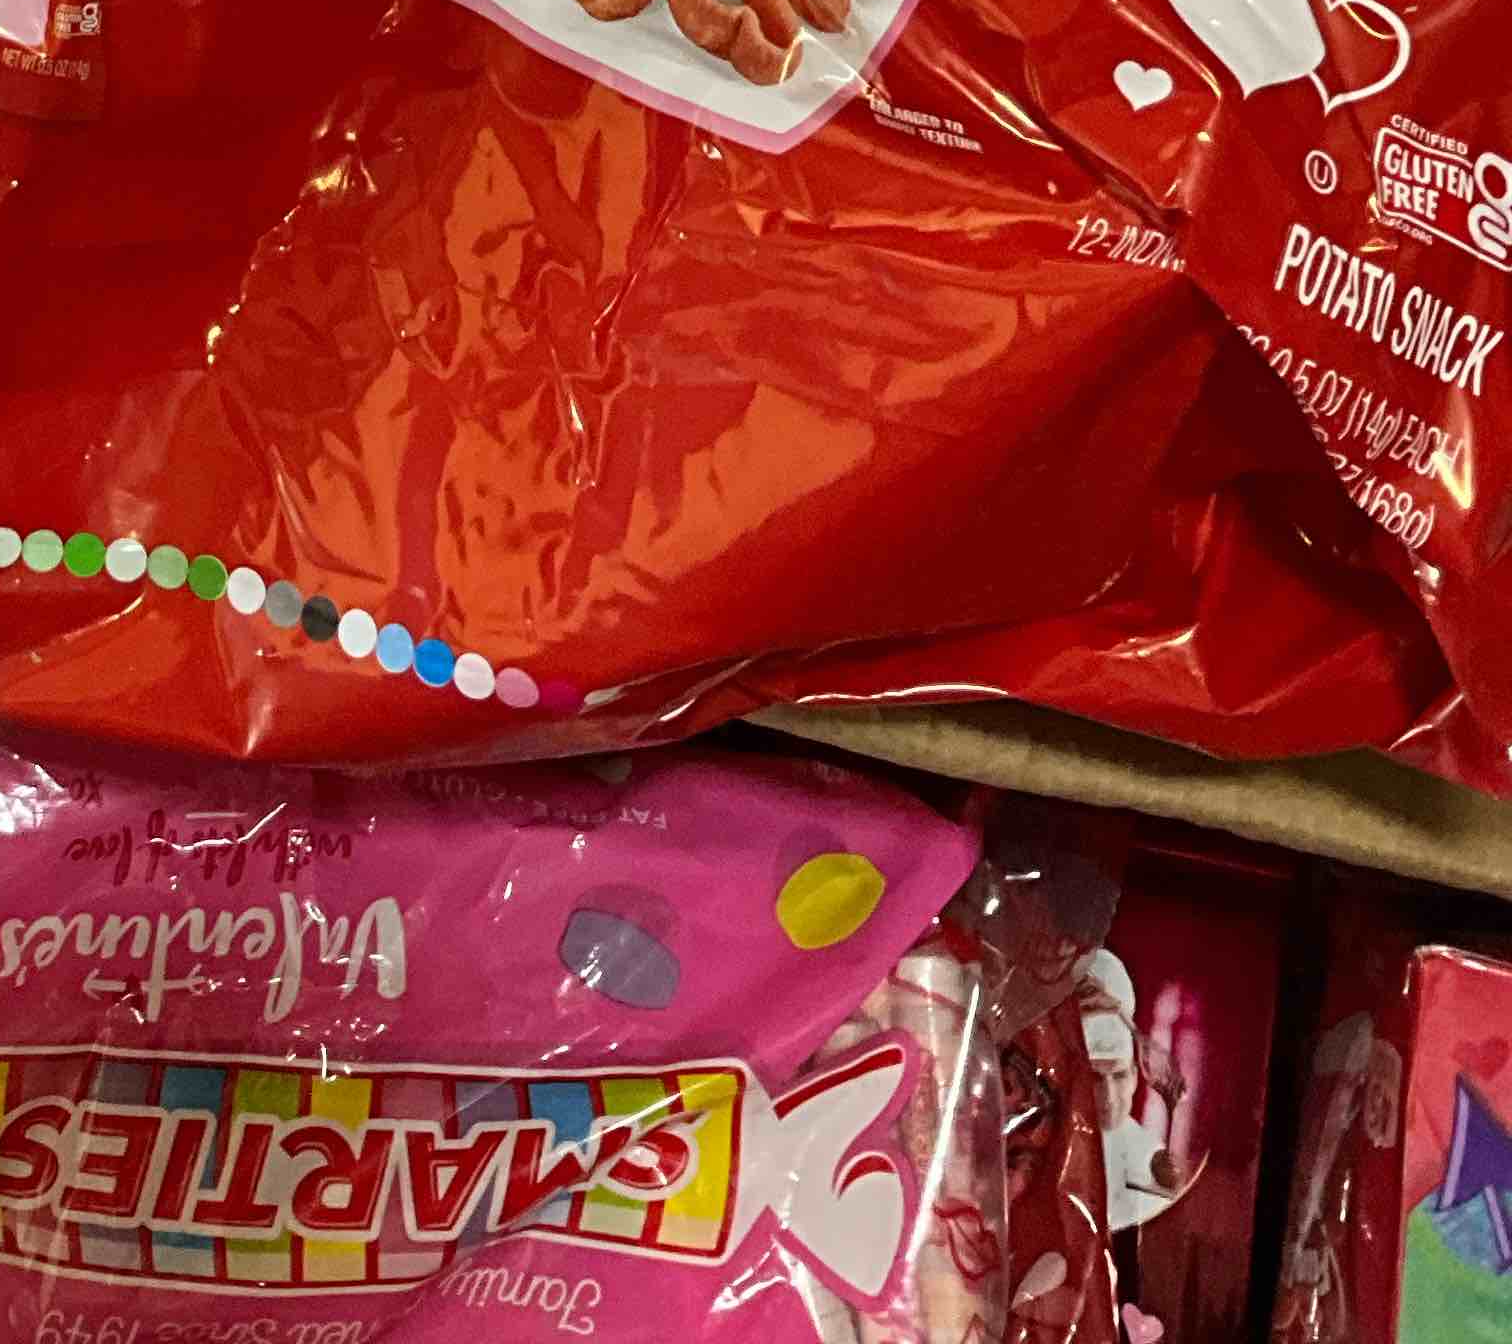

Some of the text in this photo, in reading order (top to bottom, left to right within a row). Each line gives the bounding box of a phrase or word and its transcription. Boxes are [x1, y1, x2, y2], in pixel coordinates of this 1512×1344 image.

[1391, 114, 1468, 156] CERTIFIED
[1382, 176, 1440, 220] FREE
[1384, 143, 1474, 203] GLUTEN
[1274, 223, 1505, 397] POTATO SNACK
[64, 825, 134, 887] love
[446, 1258, 602, 1335] Family
